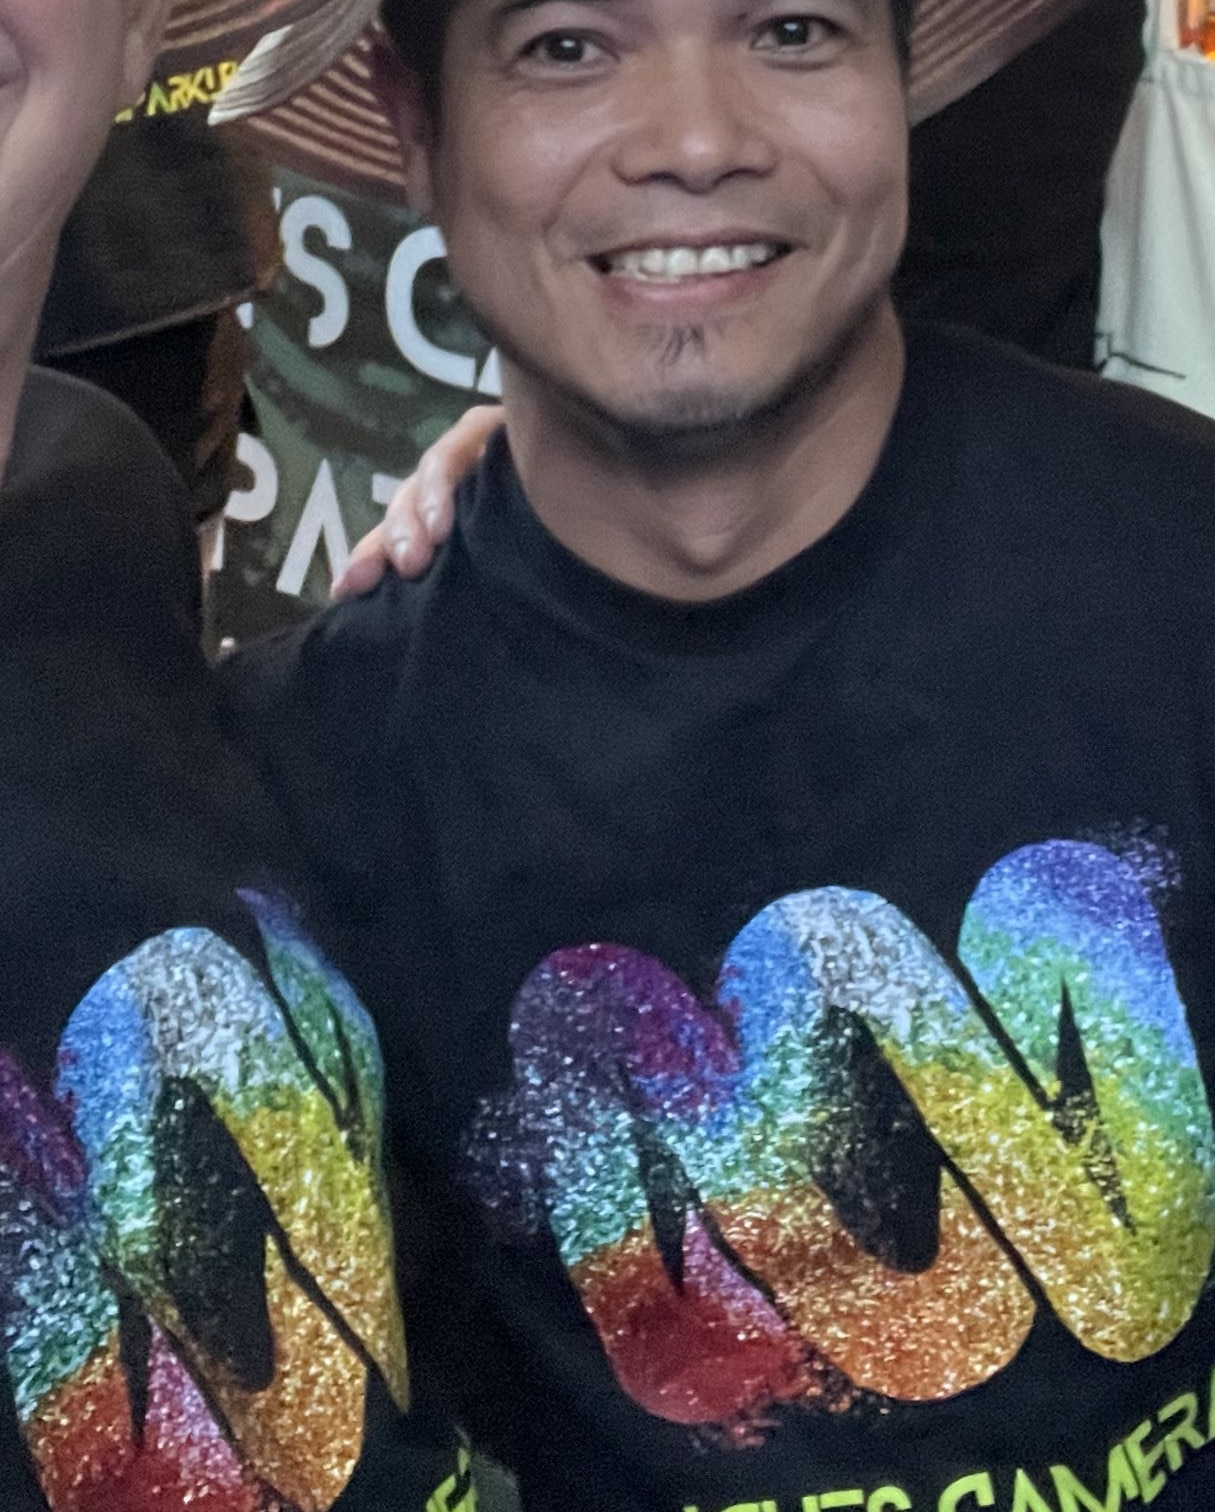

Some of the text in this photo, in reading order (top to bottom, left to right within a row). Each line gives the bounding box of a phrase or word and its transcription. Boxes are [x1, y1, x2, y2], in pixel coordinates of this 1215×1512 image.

[386, 226, 503, 397] C
[212, 433, 406, 596] PA
[938, 1366, 1215, 1512] CAMER
